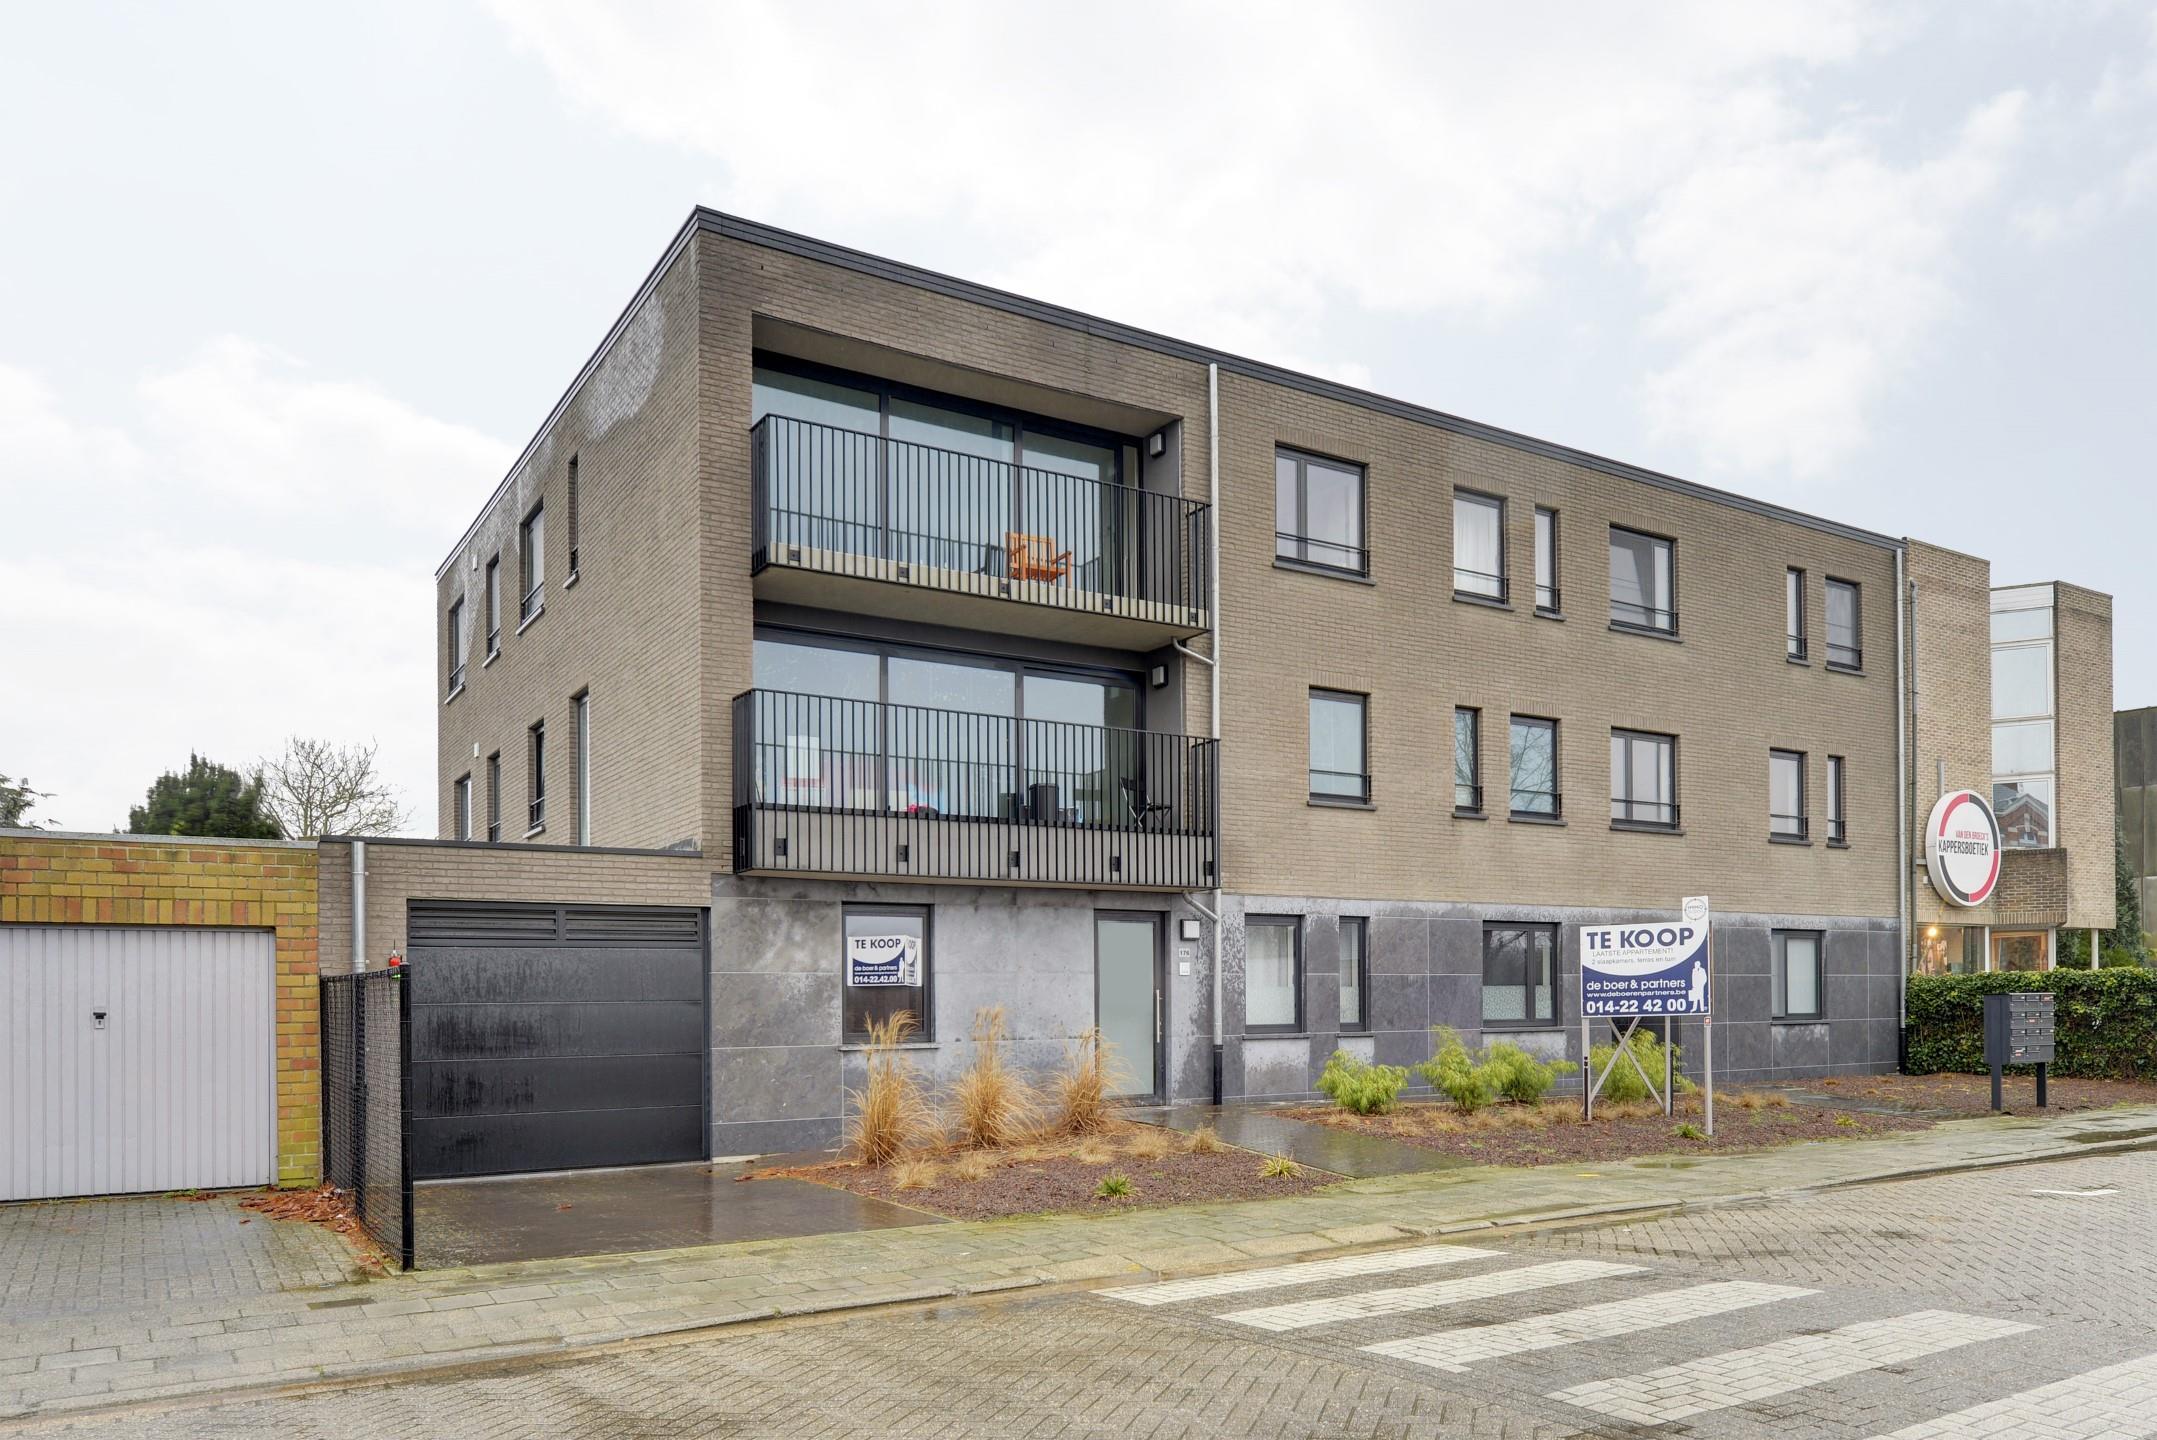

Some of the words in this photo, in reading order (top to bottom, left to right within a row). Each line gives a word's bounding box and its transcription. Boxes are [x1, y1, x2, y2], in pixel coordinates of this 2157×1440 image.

[1963, 831, 1971, 839] DEN
[1938, 840, 1988, 856] KAPPERSBOETIEK
[855, 939, 867, 949] TE
[870, 938, 901, 949] KOOP
[1586, 931, 1612, 950] TE
[1620, 927, 1694, 949] KOOP
[1586, 981, 1601, 990] de
[1603, 980, 1629, 990] boer
[1630, 979, 1638, 989] &
[1641, 978, 1686, 991] partners
[1586, 999, 1639, 1014] 014-22
[1642, 999, 1663, 1012] 42
[1666, 998, 1687, 1012] 00
